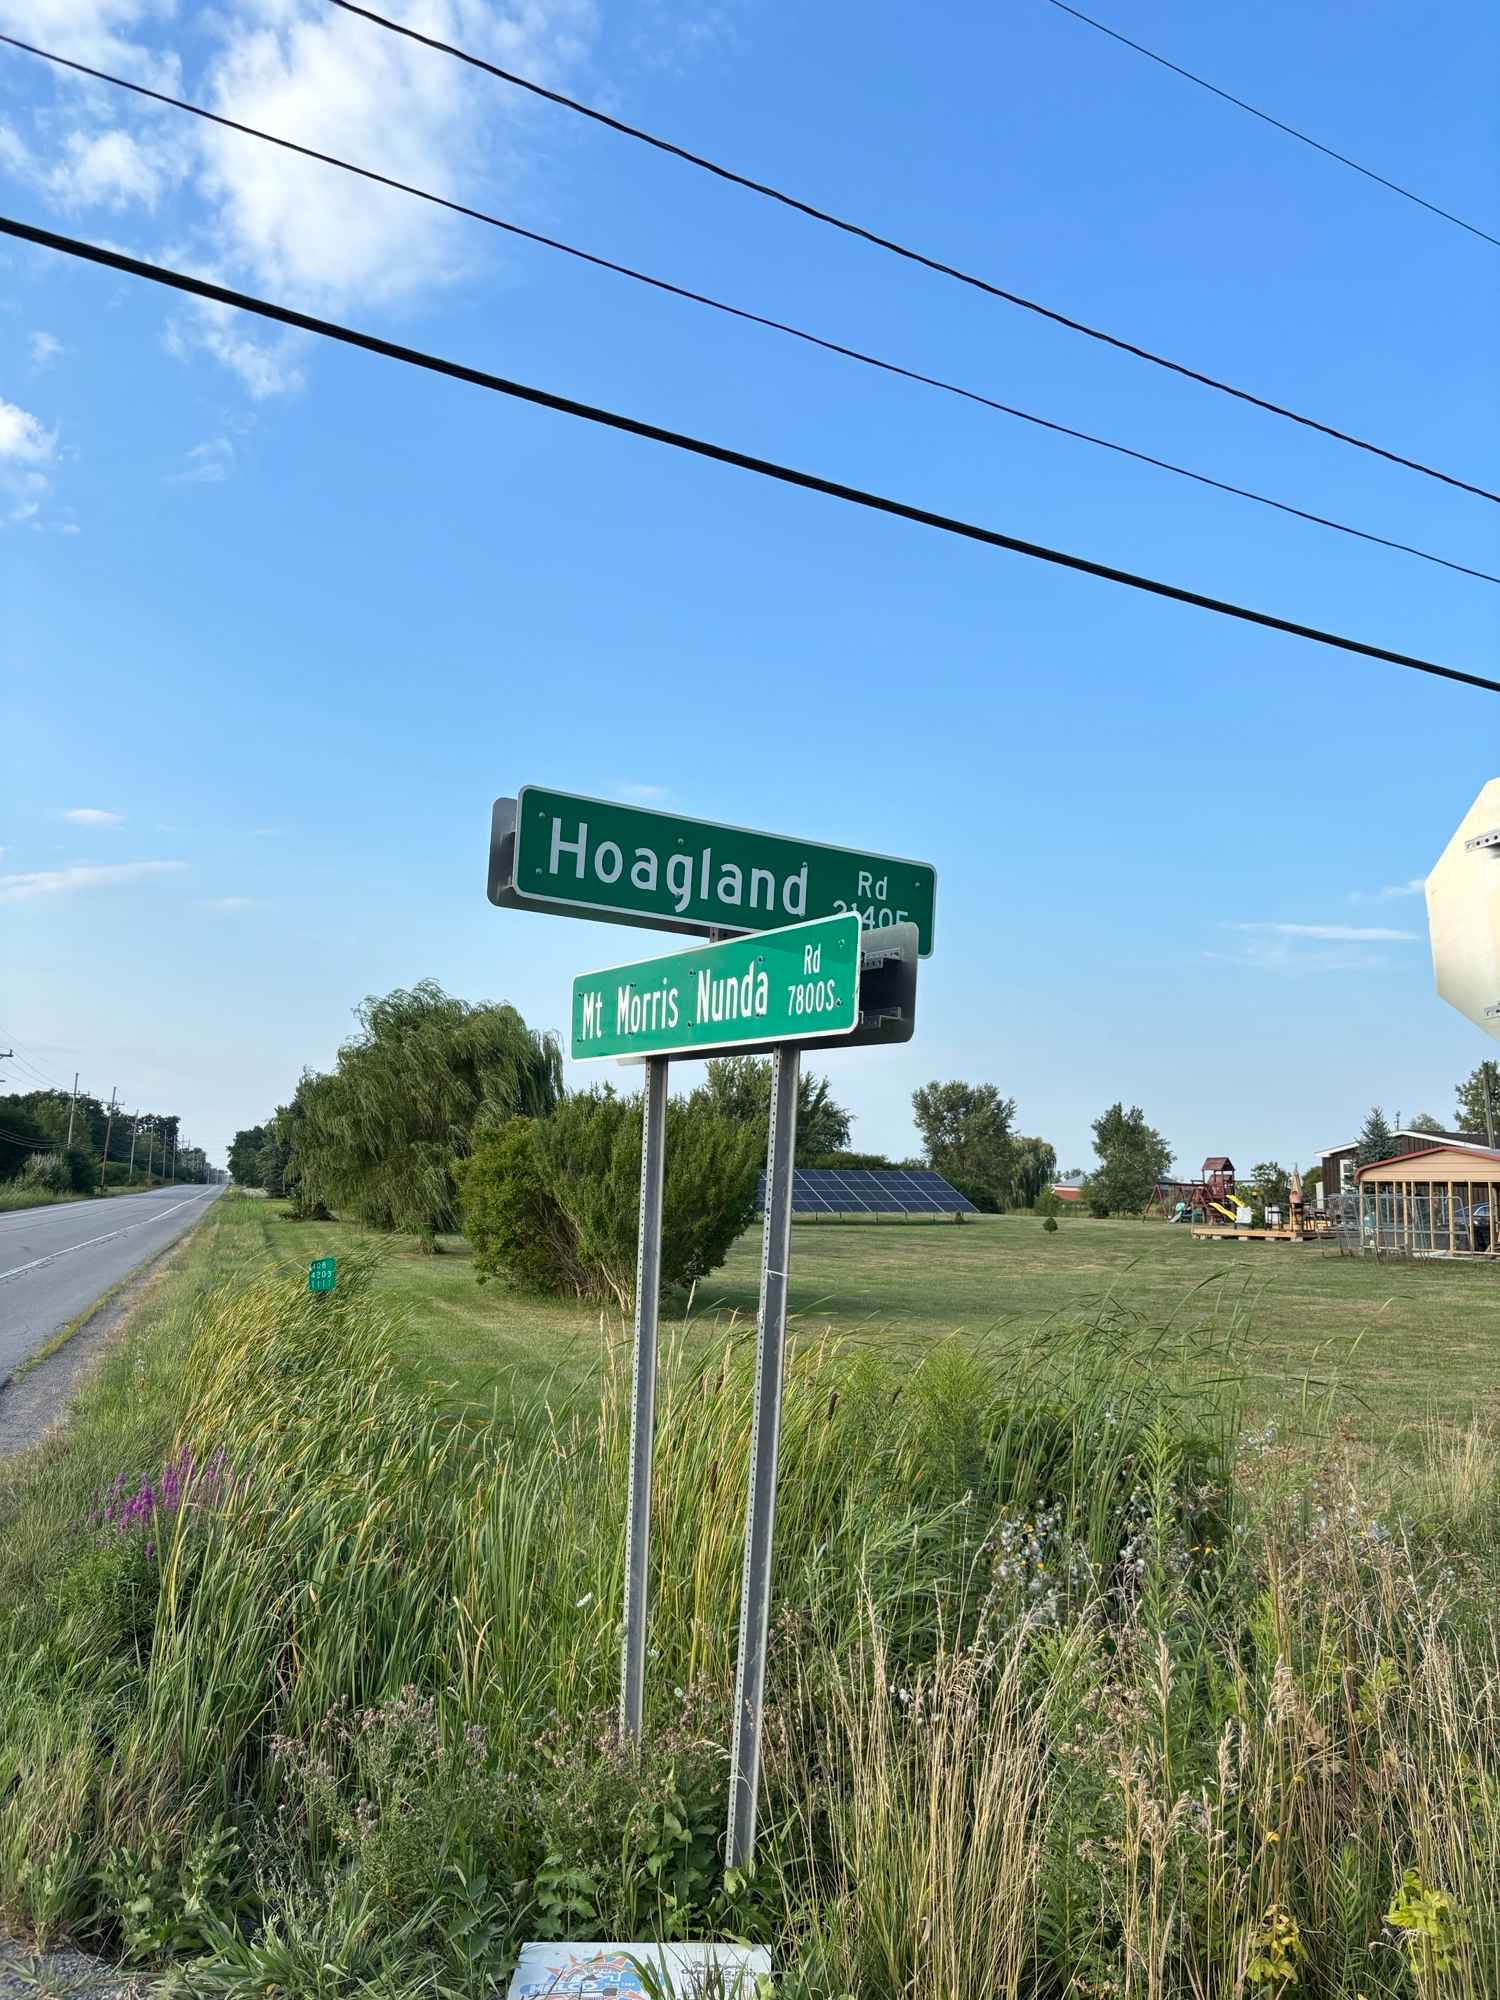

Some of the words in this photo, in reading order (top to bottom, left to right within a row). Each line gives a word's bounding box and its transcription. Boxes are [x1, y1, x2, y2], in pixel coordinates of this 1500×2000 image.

[549, 817, 808, 917] Hoagland
[857, 870, 888, 900] Rd
[804, 943, 822, 975] Rd
[582, 991, 603, 1041] Mt
[616, 977, 679, 1036] Morris
[696, 960, 769, 1025] Nunda
